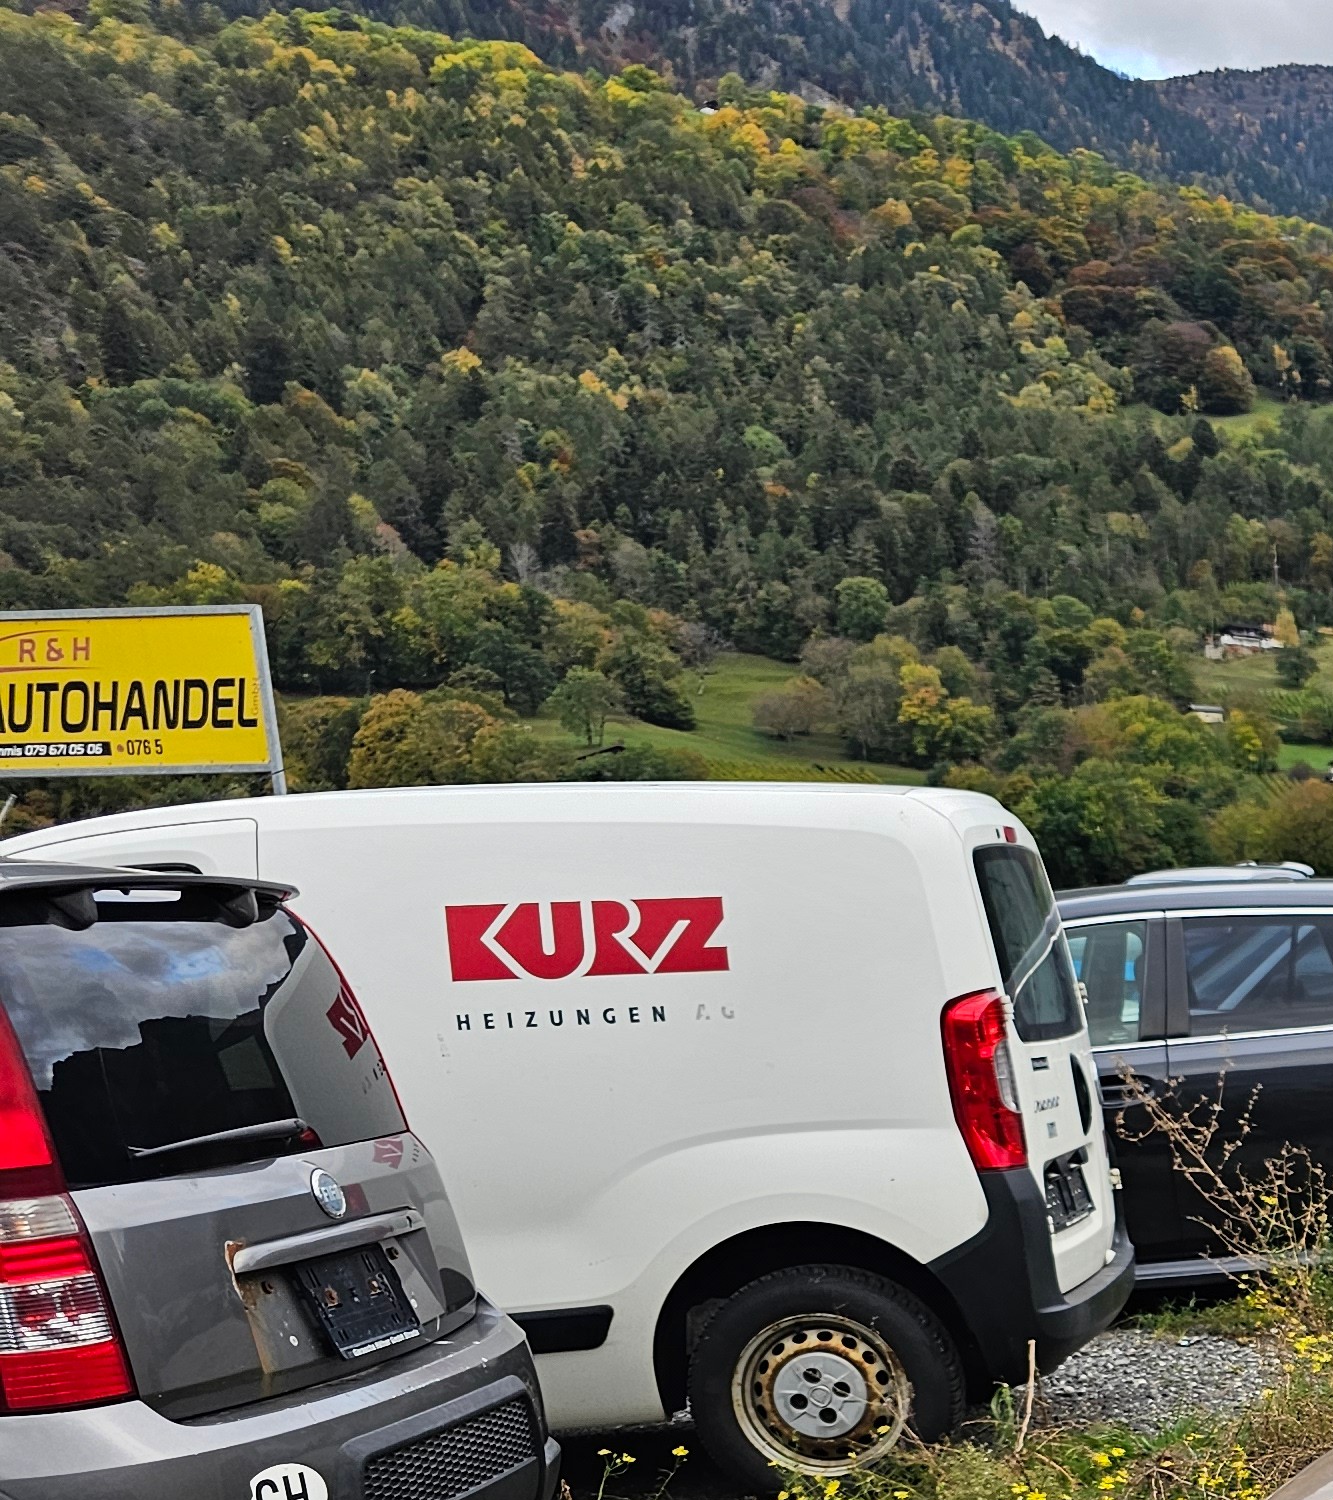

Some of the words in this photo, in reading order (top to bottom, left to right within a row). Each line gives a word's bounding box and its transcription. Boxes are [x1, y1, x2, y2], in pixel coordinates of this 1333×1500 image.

[0, 677, 258, 733] UTOHANDEL
[126, 740, 152, 756] 076
[154, 739, 163, 755] 5
[445, 897, 730, 982] KURZ
[456, 1005, 666, 1031] HEIZUNGEN
